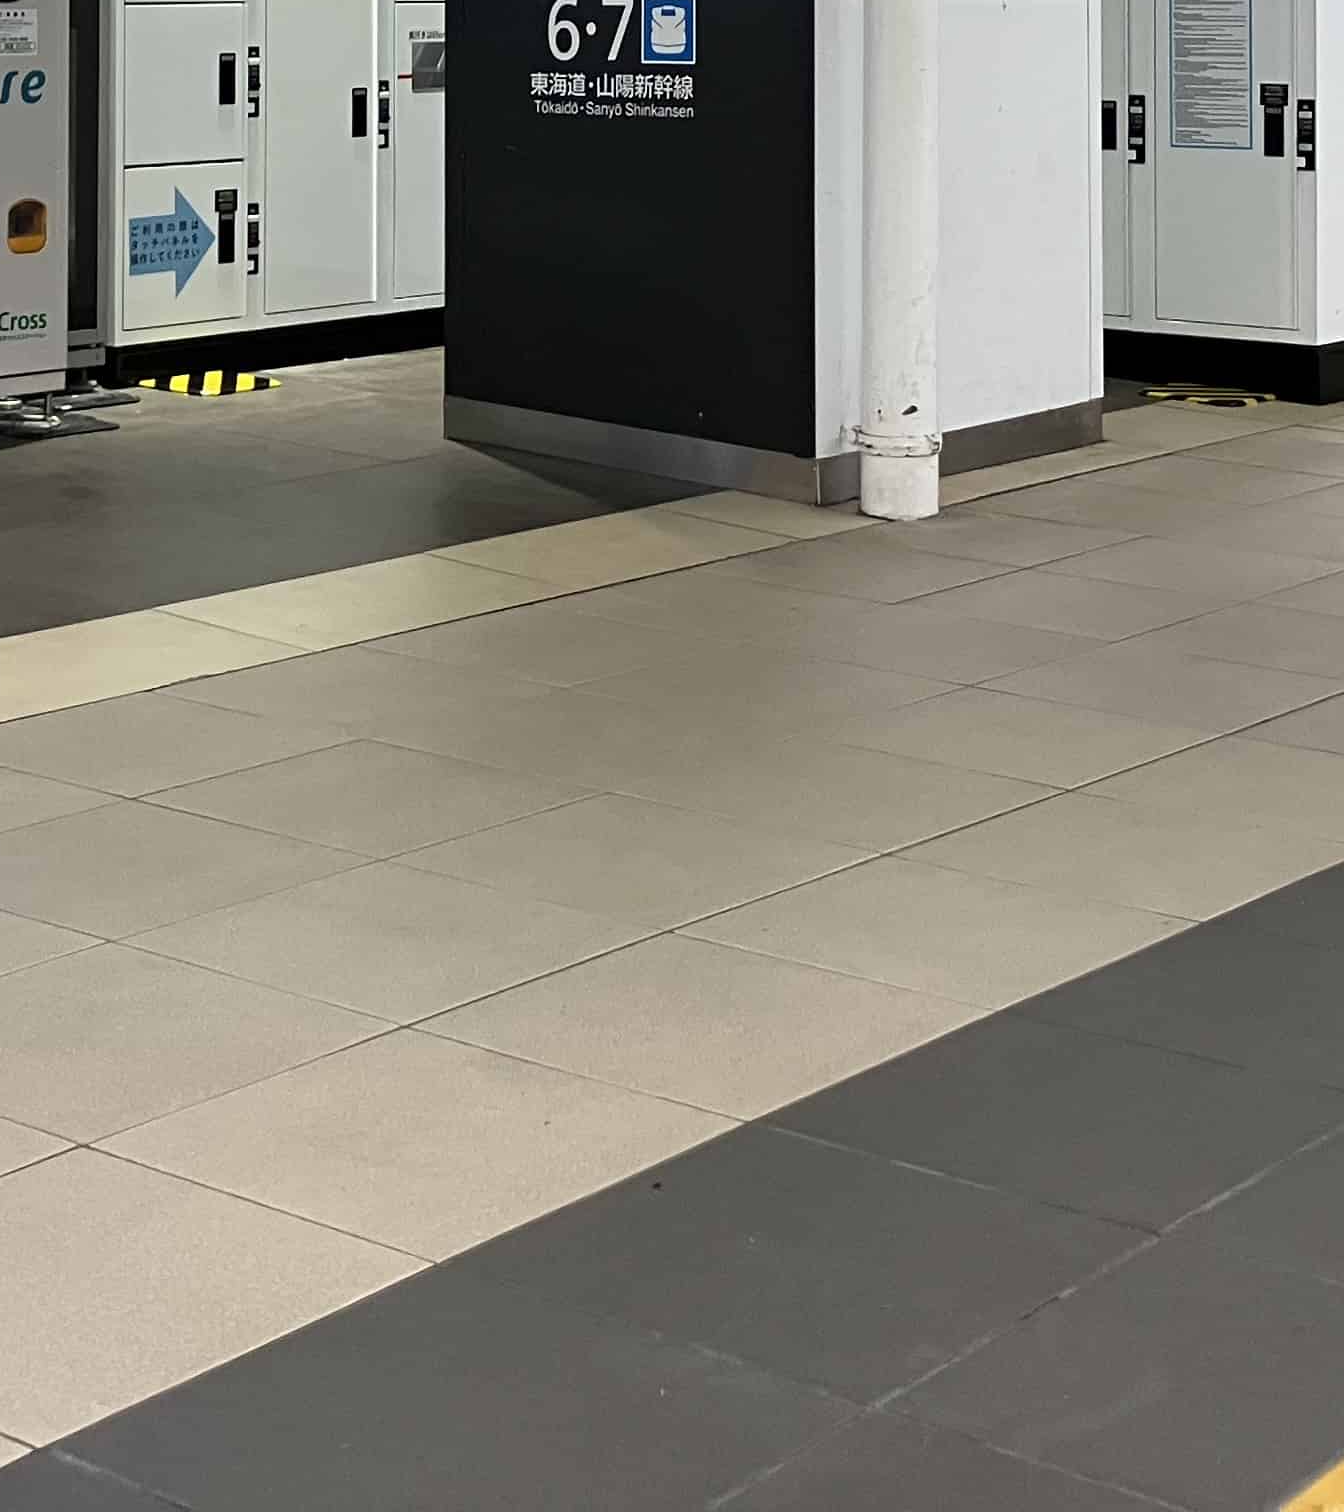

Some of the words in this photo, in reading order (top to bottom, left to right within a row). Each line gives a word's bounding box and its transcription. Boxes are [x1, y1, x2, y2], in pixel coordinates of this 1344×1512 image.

[529, 72, 695, 101] 東海道・山陽新幹線
[624, 102, 695, 119] Shinkansen
